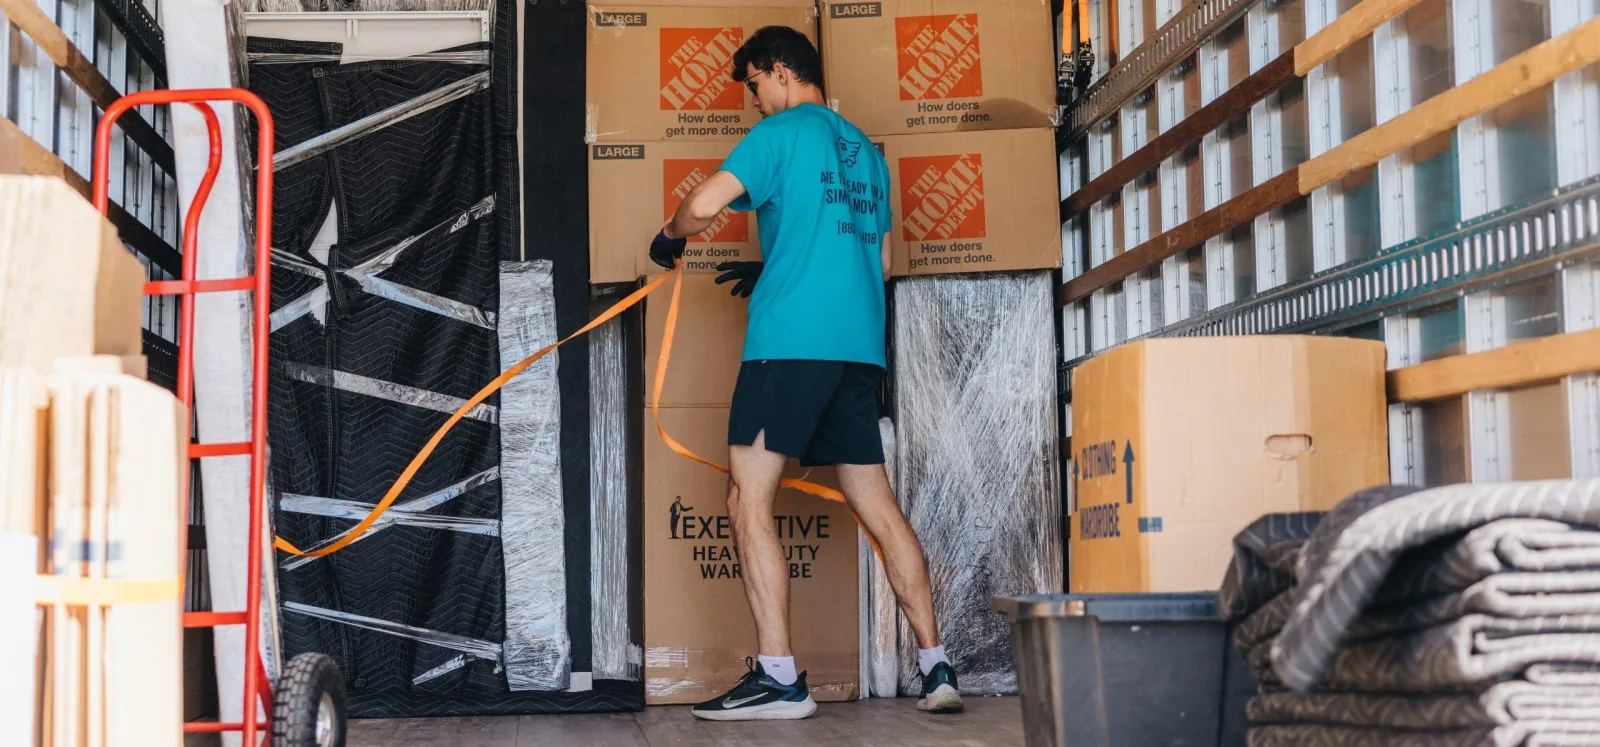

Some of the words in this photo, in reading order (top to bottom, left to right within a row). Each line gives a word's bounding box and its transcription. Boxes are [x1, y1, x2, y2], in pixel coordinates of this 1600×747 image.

[835, 4, 876, 16] LARGE
[600, 15, 642, 24] LARGE
[905, 24, 938, 58] THE
[668, 36, 703, 69] THE
[899, 13, 979, 101] HOME
[660, 28, 743, 110] HOME
[931, 45, 980, 99] DEPOT
[693, 62, 735, 111] DEPO
[918, 102, 945, 113] How
[947, 101, 979, 111] doers
[678, 113, 704, 123] How
[707, 113, 740, 123] doers
[906, 115, 925, 127] get
[928, 115, 957, 124] more
[666, 126, 686, 137] get
[688, 127, 718, 135] more
[597, 147, 640, 157] LARGE
[671, 167, 707, 200] THE
[844, 180, 867, 195] EADY
[908, 164, 942, 199] THE
[902, 153, 983, 241] HOME
[853, 198, 877, 214] MOV
[935, 184, 984, 240] DEPOT
[683, 248, 702, 257] ow
[706, 247, 740, 257] doers
[921, 243, 946, 254] How
[950, 241, 982, 252] doers
[687, 261, 717, 269] more
[909, 256, 928, 269] get
[931, 255, 961, 265] more
[964, 253, 996, 263] done.
[1081, 439, 1117, 480] CLOTHING
[682, 515, 829, 539] EXETIVE
[1080, 502, 1120, 540] WARDROBE
[782, 545, 820, 561] UTY
[700, 563, 812, 579] WARBE
